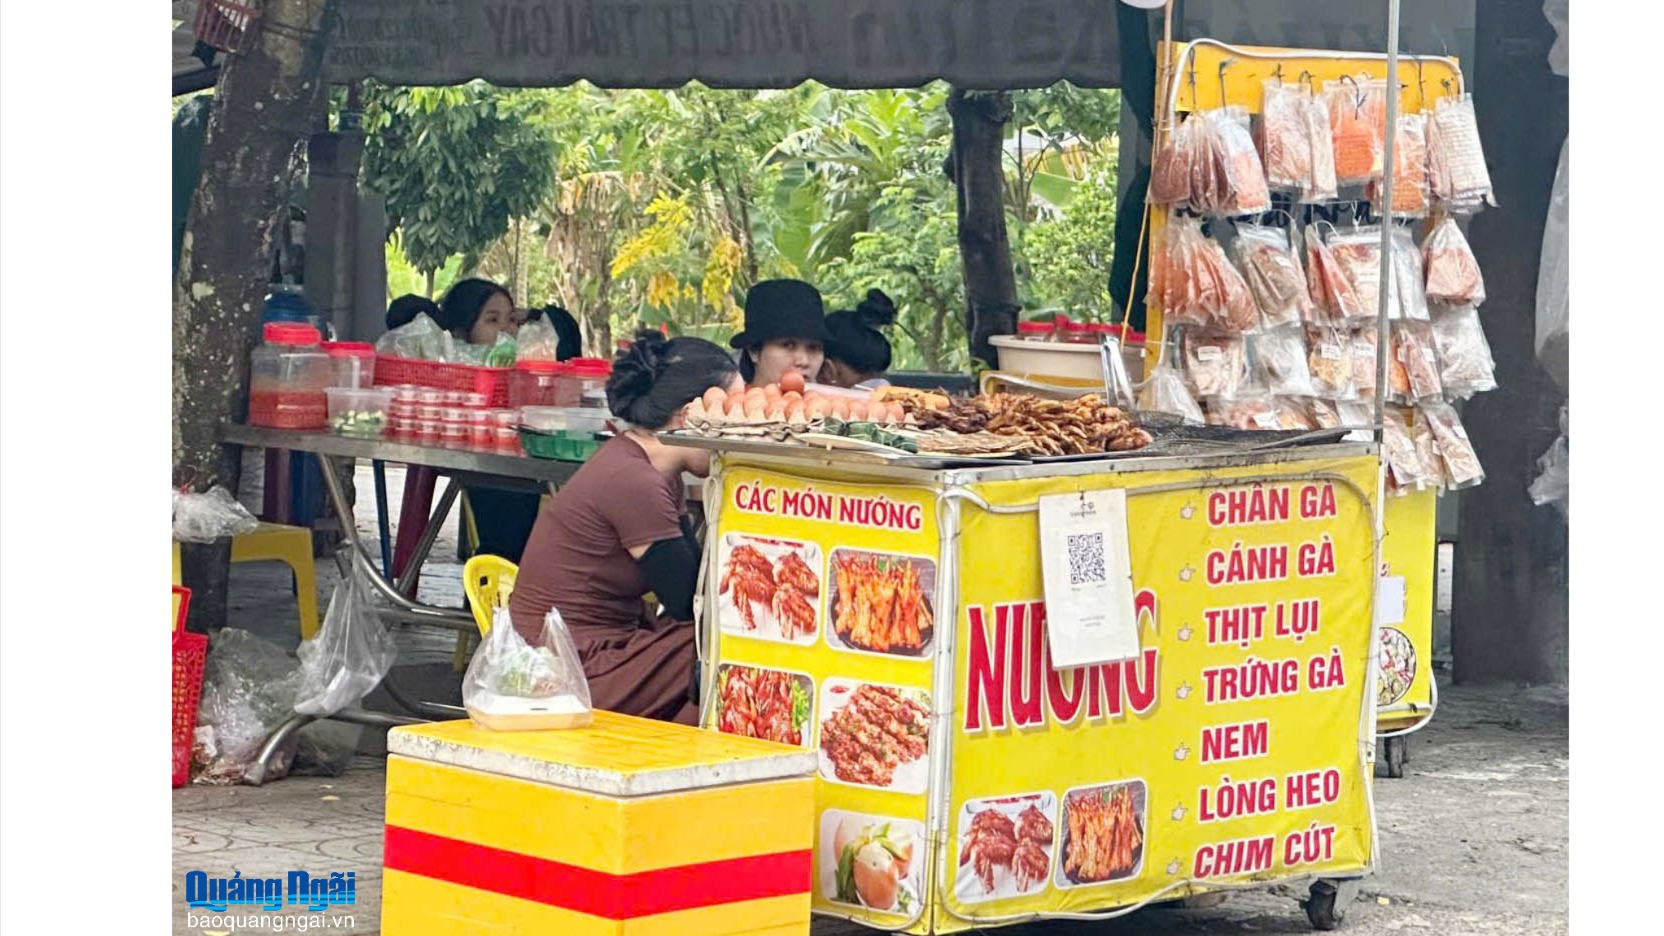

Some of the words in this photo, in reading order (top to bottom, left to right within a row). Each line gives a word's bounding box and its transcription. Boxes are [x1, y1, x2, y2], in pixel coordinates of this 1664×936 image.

[735, 480, 776, 513] CÁC
[781, 487, 833, 520] MÓN
[839, 496, 921, 531] NƯỚNG
[1207, 482, 1290, 526] CHÂN
[1299, 479, 1337, 519] GÀ
[1206, 542, 1288, 585] CÁNH
[1297, 535, 1336, 577] GÀ
[1205, 605, 1267, 647] THỊT
[1275, 600, 1320, 641] LỤI
[1203, 658, 1299, 703] TRỨNG
[1307, 648, 1345, 690] GÀ
[1201, 721, 1268, 763] NEM
[1199, 777, 1277, 822] LÒNG
[1286, 769, 1341, 808] HEO
[1193, 837, 1275, 880] CHIM
[1283, 823, 1336, 867] CÚT
